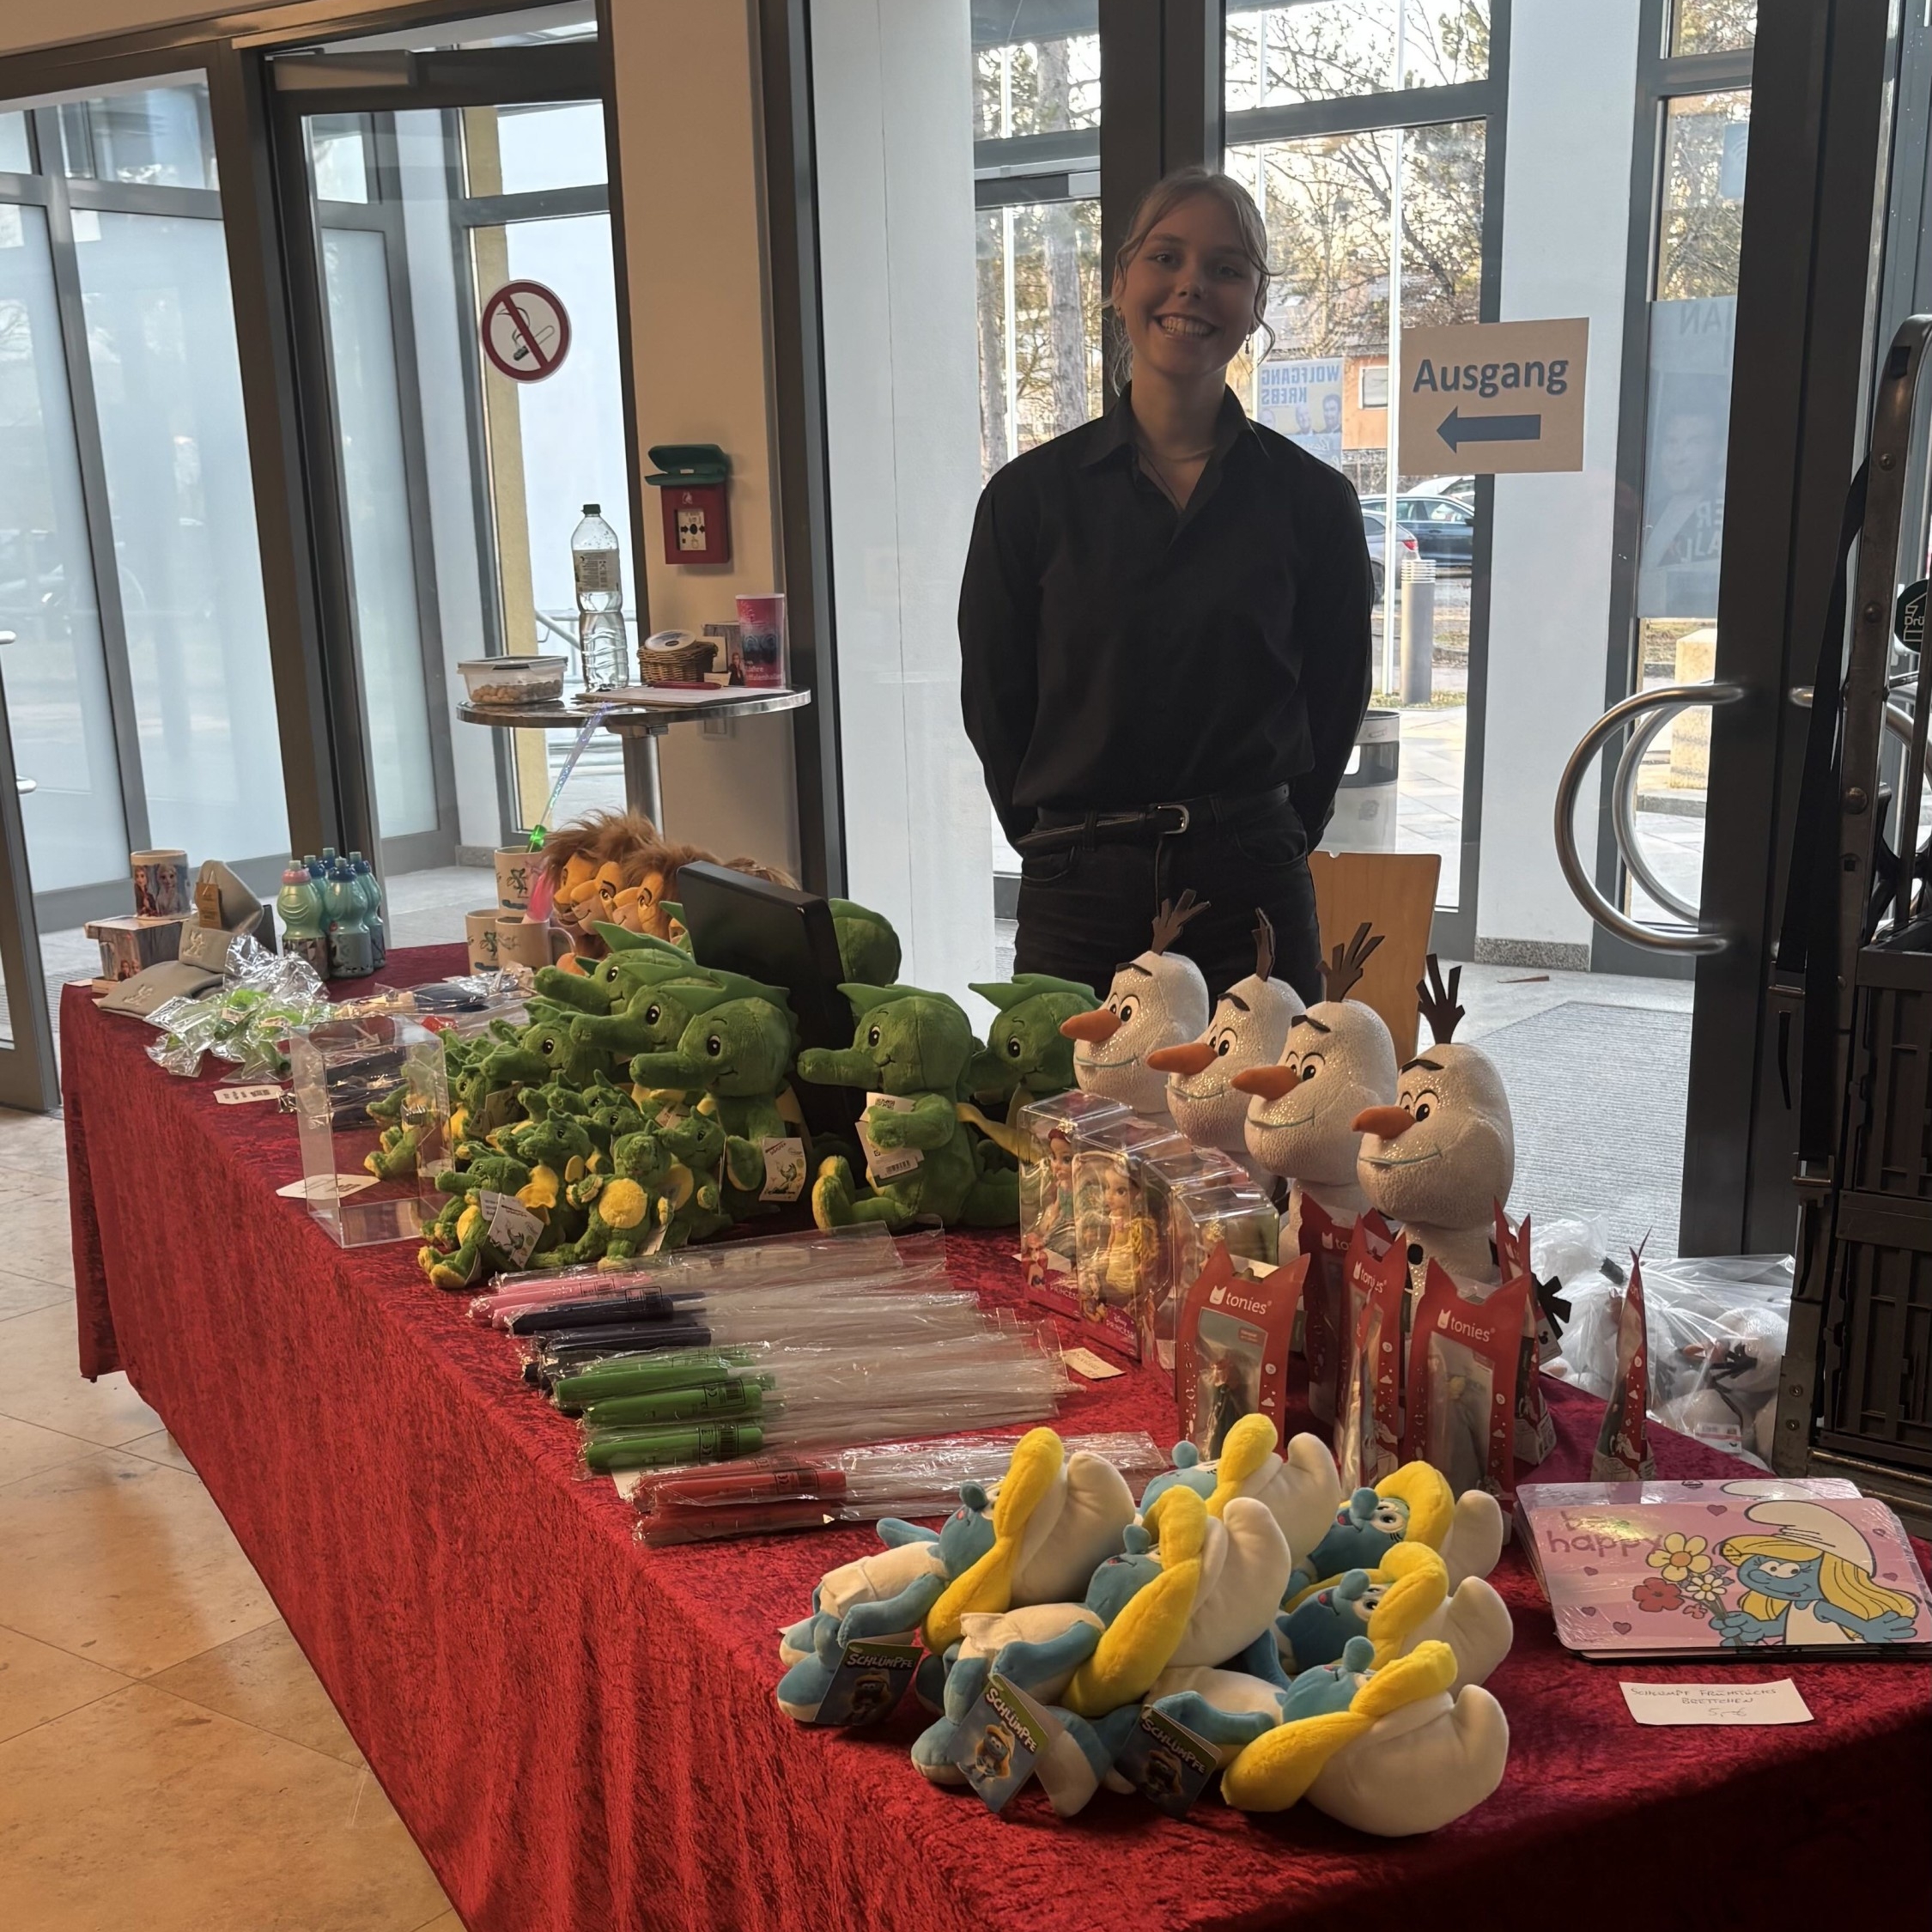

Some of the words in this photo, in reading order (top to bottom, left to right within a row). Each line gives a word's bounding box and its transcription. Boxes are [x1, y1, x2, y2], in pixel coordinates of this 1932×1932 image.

[1413, 359, 1569, 398] Ausgang
[1226, 1292, 1267, 1315] tonies
[1451, 1316, 1491, 1343] tonies
[1546, 1530, 1664, 1558] happy
[846, 1653, 914, 1668] SCHLÜMPFE
[986, 1687, 1037, 1753] SCHLÜMPFE
